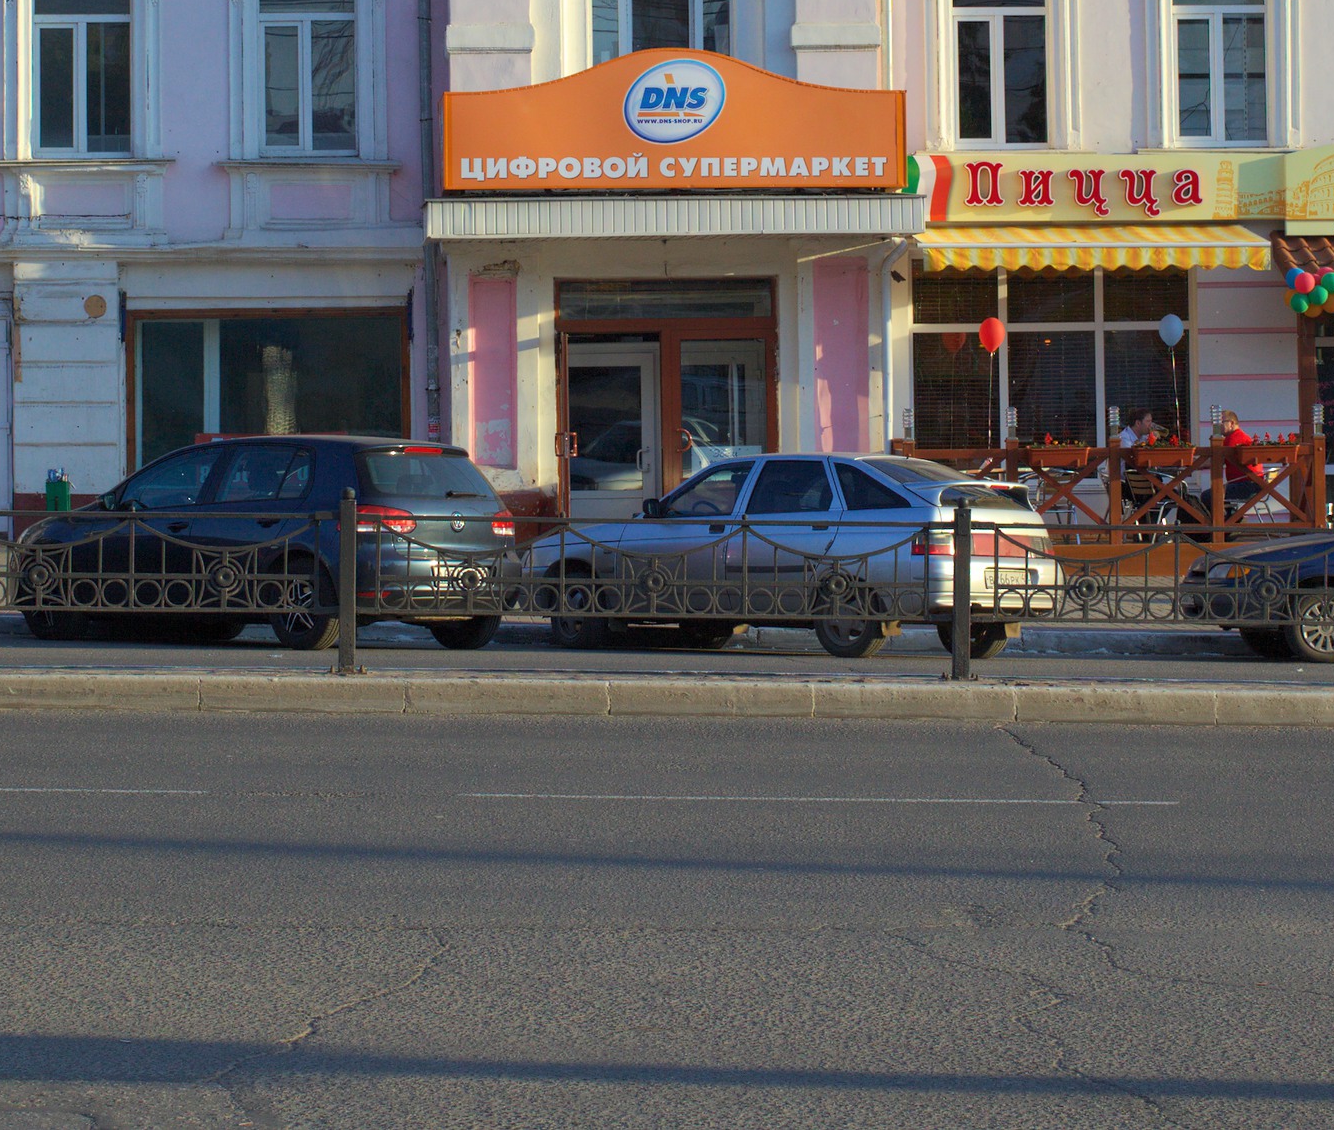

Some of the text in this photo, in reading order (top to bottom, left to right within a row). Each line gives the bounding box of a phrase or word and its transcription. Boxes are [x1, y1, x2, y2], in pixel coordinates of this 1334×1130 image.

[640, 86, 709, 111] DNS
[460, 153, 888, 181] ЦИФРОВОЙ СУПЕРМАРКЕТ
[964, 160, 1204, 218] Пицца
